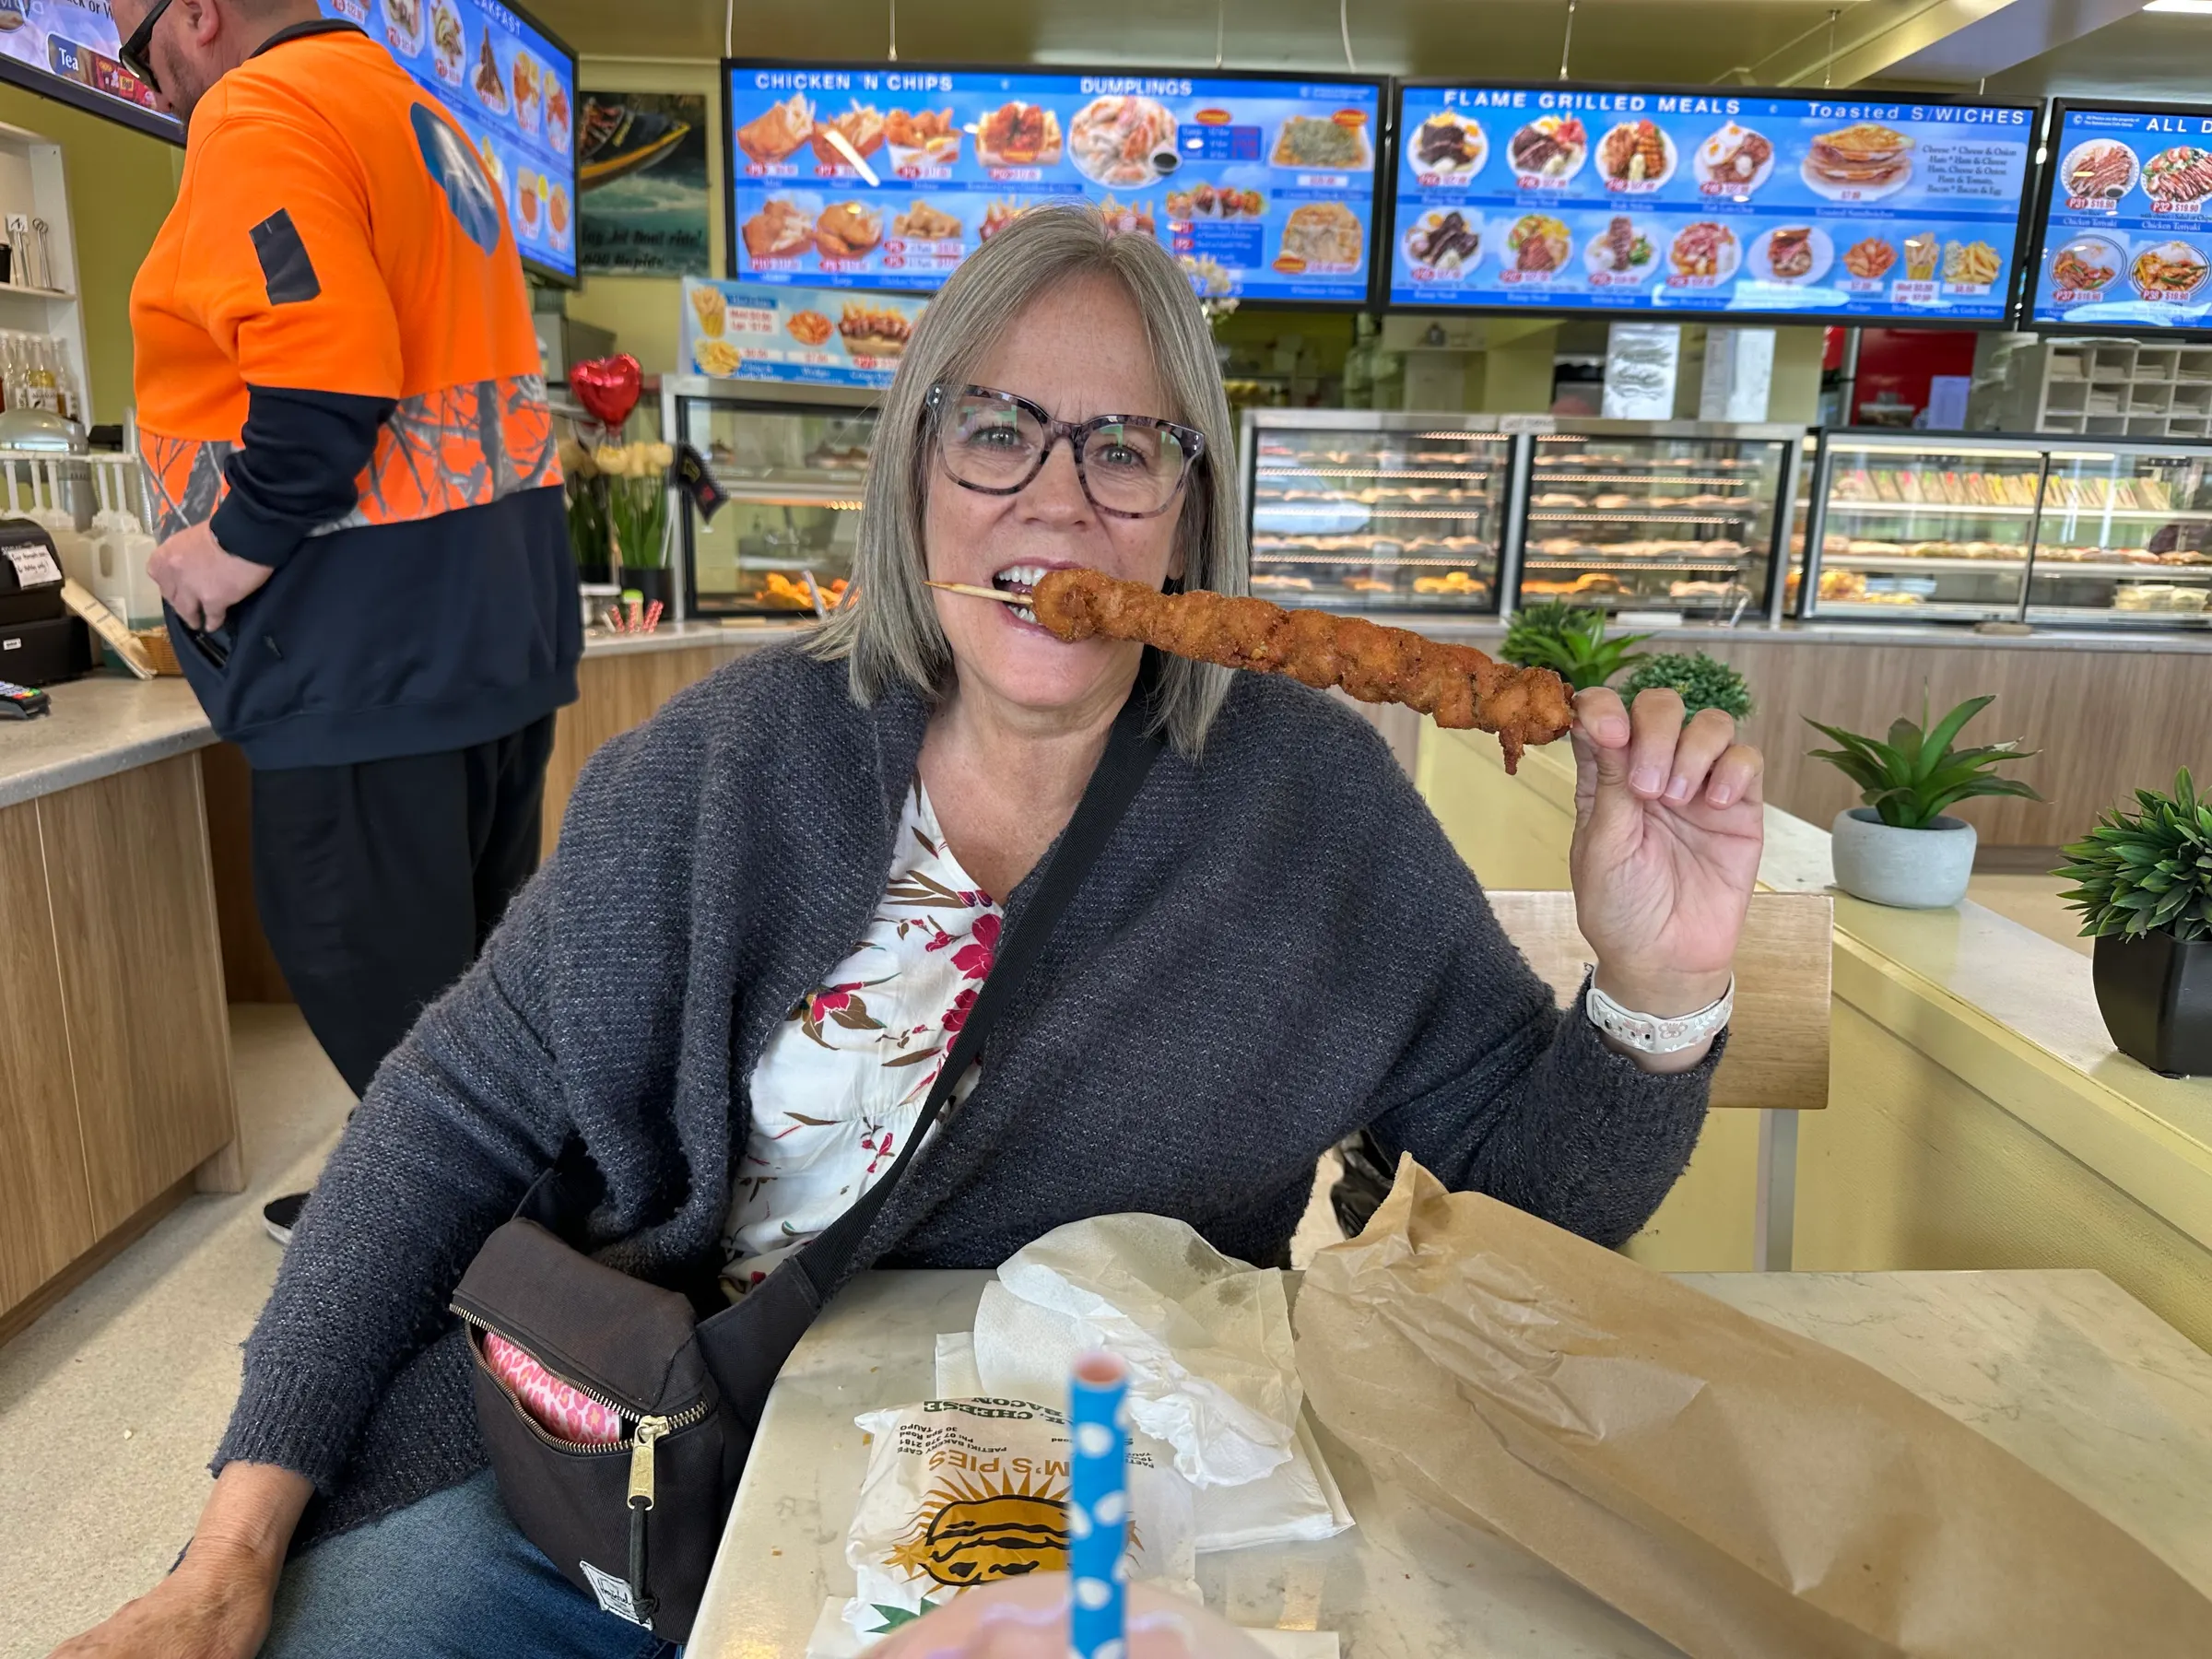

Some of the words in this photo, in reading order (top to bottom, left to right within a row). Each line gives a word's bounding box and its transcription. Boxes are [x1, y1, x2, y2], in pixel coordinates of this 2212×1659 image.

[90, 1, 100, 15] or
[58, 47, 79, 72] Tea
[755, 73, 851, 90] CHICKEN
[887, 74, 953, 92] CHIPS
[1080, 76, 1193, 96] DUMPLINGS
[1443, 89, 1527, 109] FLAME
[1537, 94, 1646, 112] GRILLED
[1657, 98, 1741, 115] MEALS
[1808, 102, 1899, 120] Toasted
[1911, 106, 2025, 124] S/WICHES
[2146, 117, 2187, 133] ALL
[1923, 145, 1949, 154] Cheese
[1959, 146, 1983, 155] Cheese
[1994, 147, 2017, 156] Onion
[1982, 158, 2007, 166] Cheese
[1948, 166, 1973, 174] Cheese
[1927, 184, 1949, 193] Bacon
[1957, 185, 1979, 194] Bacon
[2068, 198, 2086, 209] P31
[2153, 201, 2171, 212] P32
[2175, 203, 2199, 213] $19.90
[2064, 218, 2090, 226] Chicken
[2092, 218, 2117, 228] Teriyaki
[2142, 220, 2171, 229] Chicken
[2173, 221, 2201, 231] Teriyaki
[924, 1400, 1033, 1419] CHEESE
[971, 1397, 1065, 1418] BACON
[900, 1424, 932, 1433] TAUPO
[900, 1430, 923, 1441] Road
[925, 1435, 942, 1448] 378
[900, 1438, 922, 1448] 2181
[925, 1439, 965, 1455] BAKERY
[967, 1441, 1007, 1453] PAETIKI
[928, 1448, 1000, 1473] PIES
